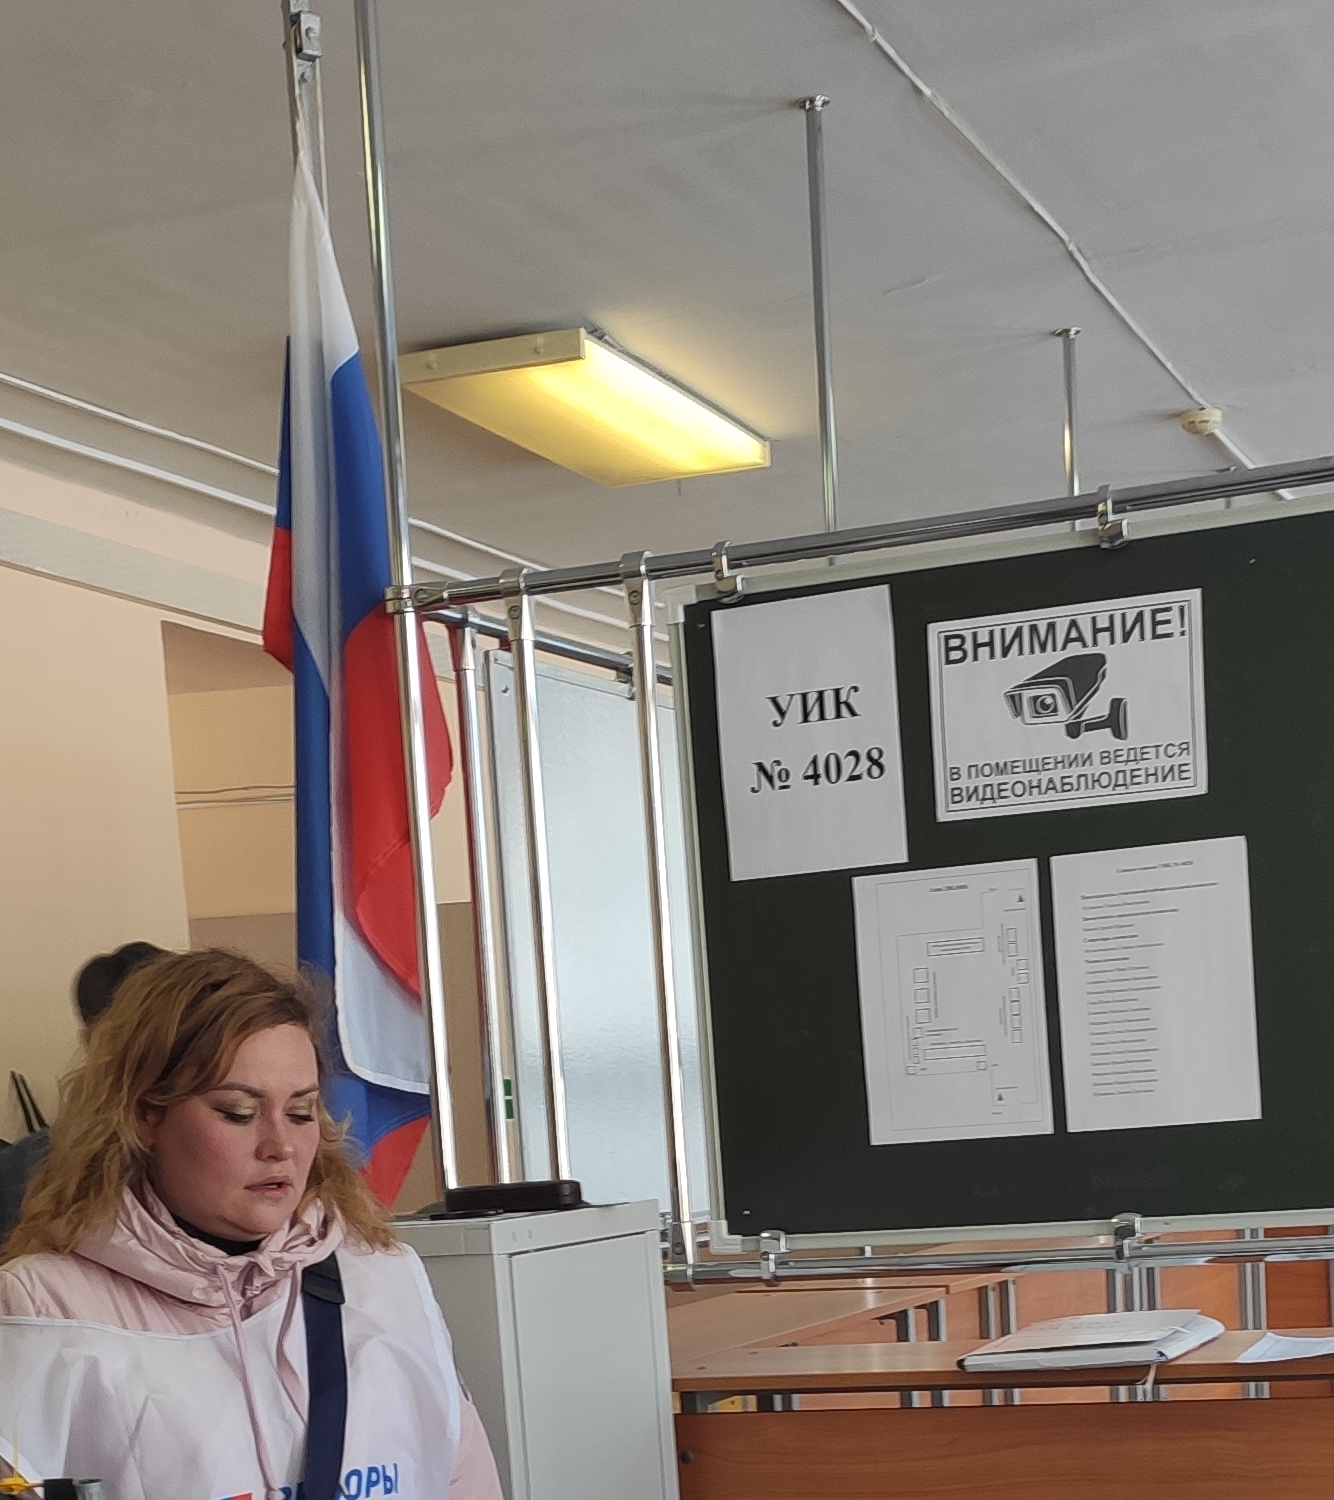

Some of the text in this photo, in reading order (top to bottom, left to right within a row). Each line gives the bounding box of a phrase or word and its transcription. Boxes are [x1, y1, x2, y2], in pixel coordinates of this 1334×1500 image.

[943, 604, 1188, 665] ВНИМАНИЕ!
[766, 685, 862, 727] УИК
[750, 747, 886, 793] № 4028
[950, 741, 1191, 782] В ПОМЕЩЕНИИ ВЕДЕТСЯ
[950, 763, 1192, 805] ВИДЕОНАБЛЮДЕНИЕ
